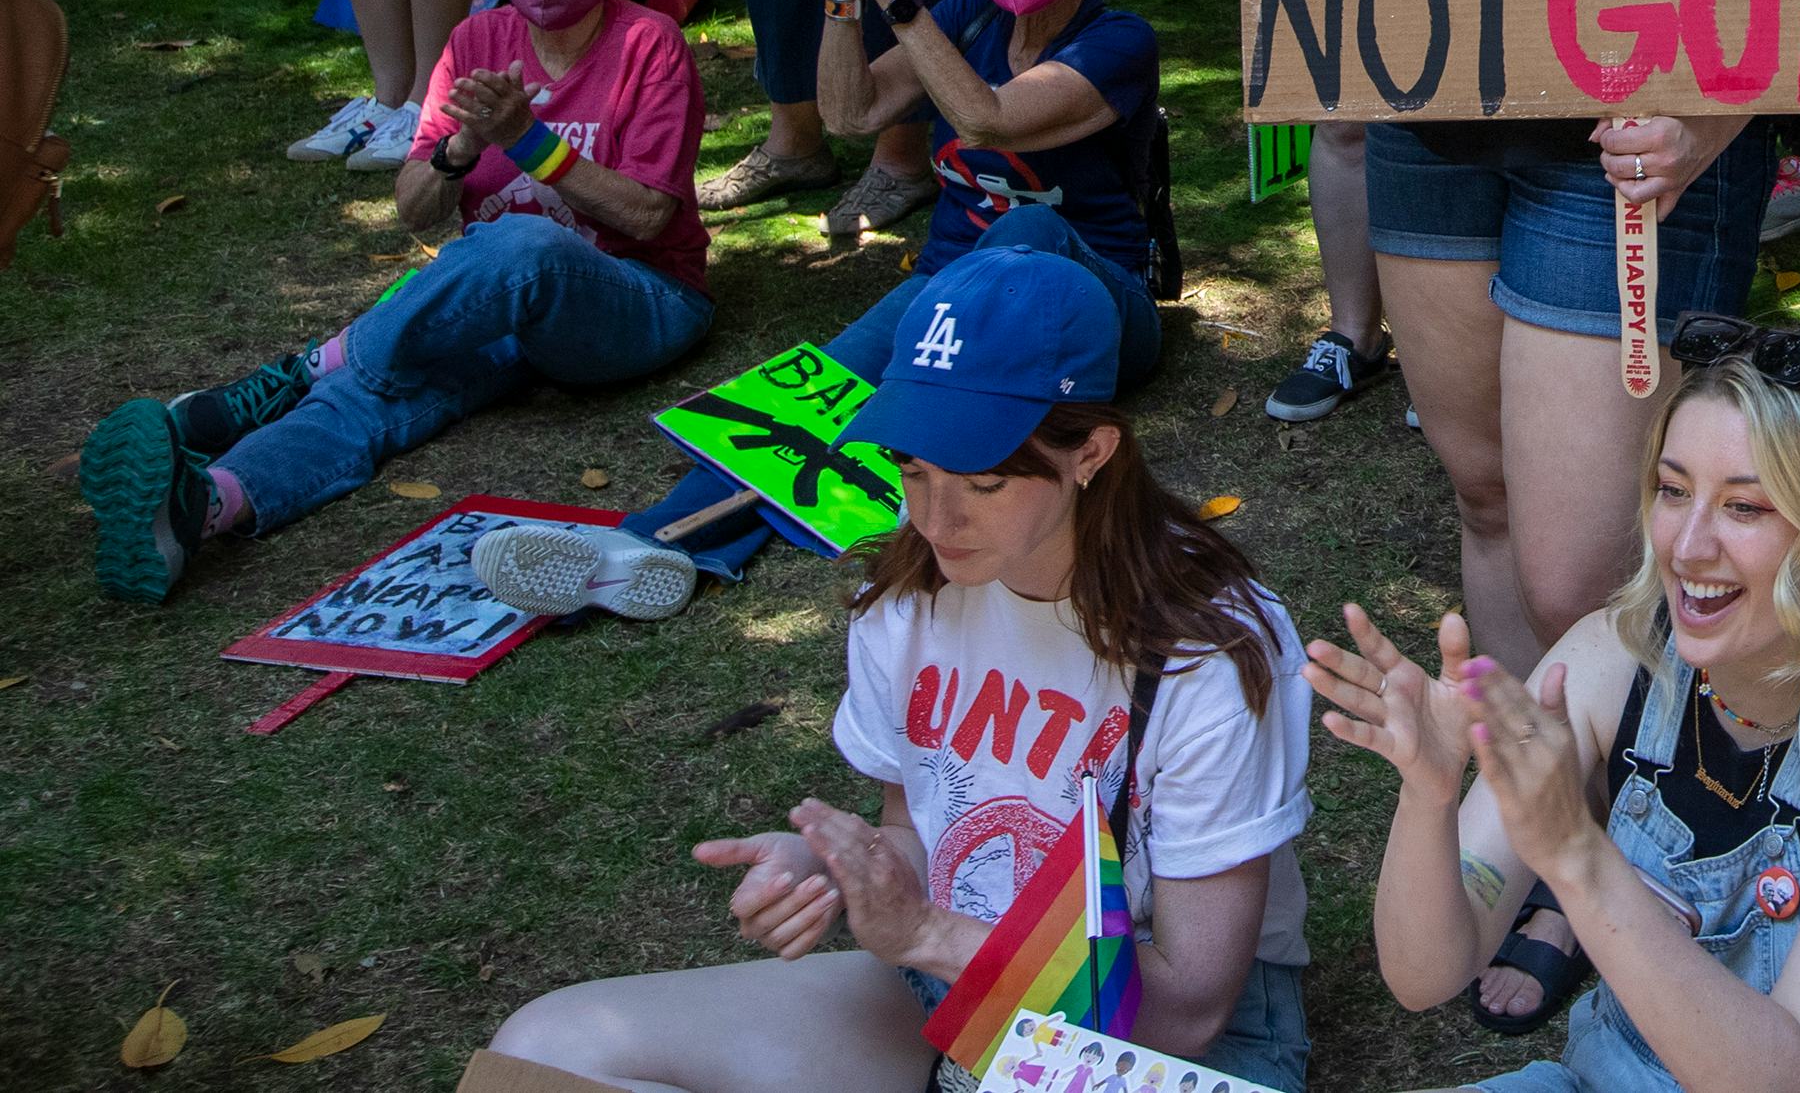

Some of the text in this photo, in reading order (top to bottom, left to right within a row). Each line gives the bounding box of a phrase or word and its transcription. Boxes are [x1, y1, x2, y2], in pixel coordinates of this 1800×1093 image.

[1625, 244, 1647, 335] HAPPY
[912, 303, 964, 371] LA
[327, 575, 503, 611] WEAPO
[906, 664, 1132, 782] UNTI
